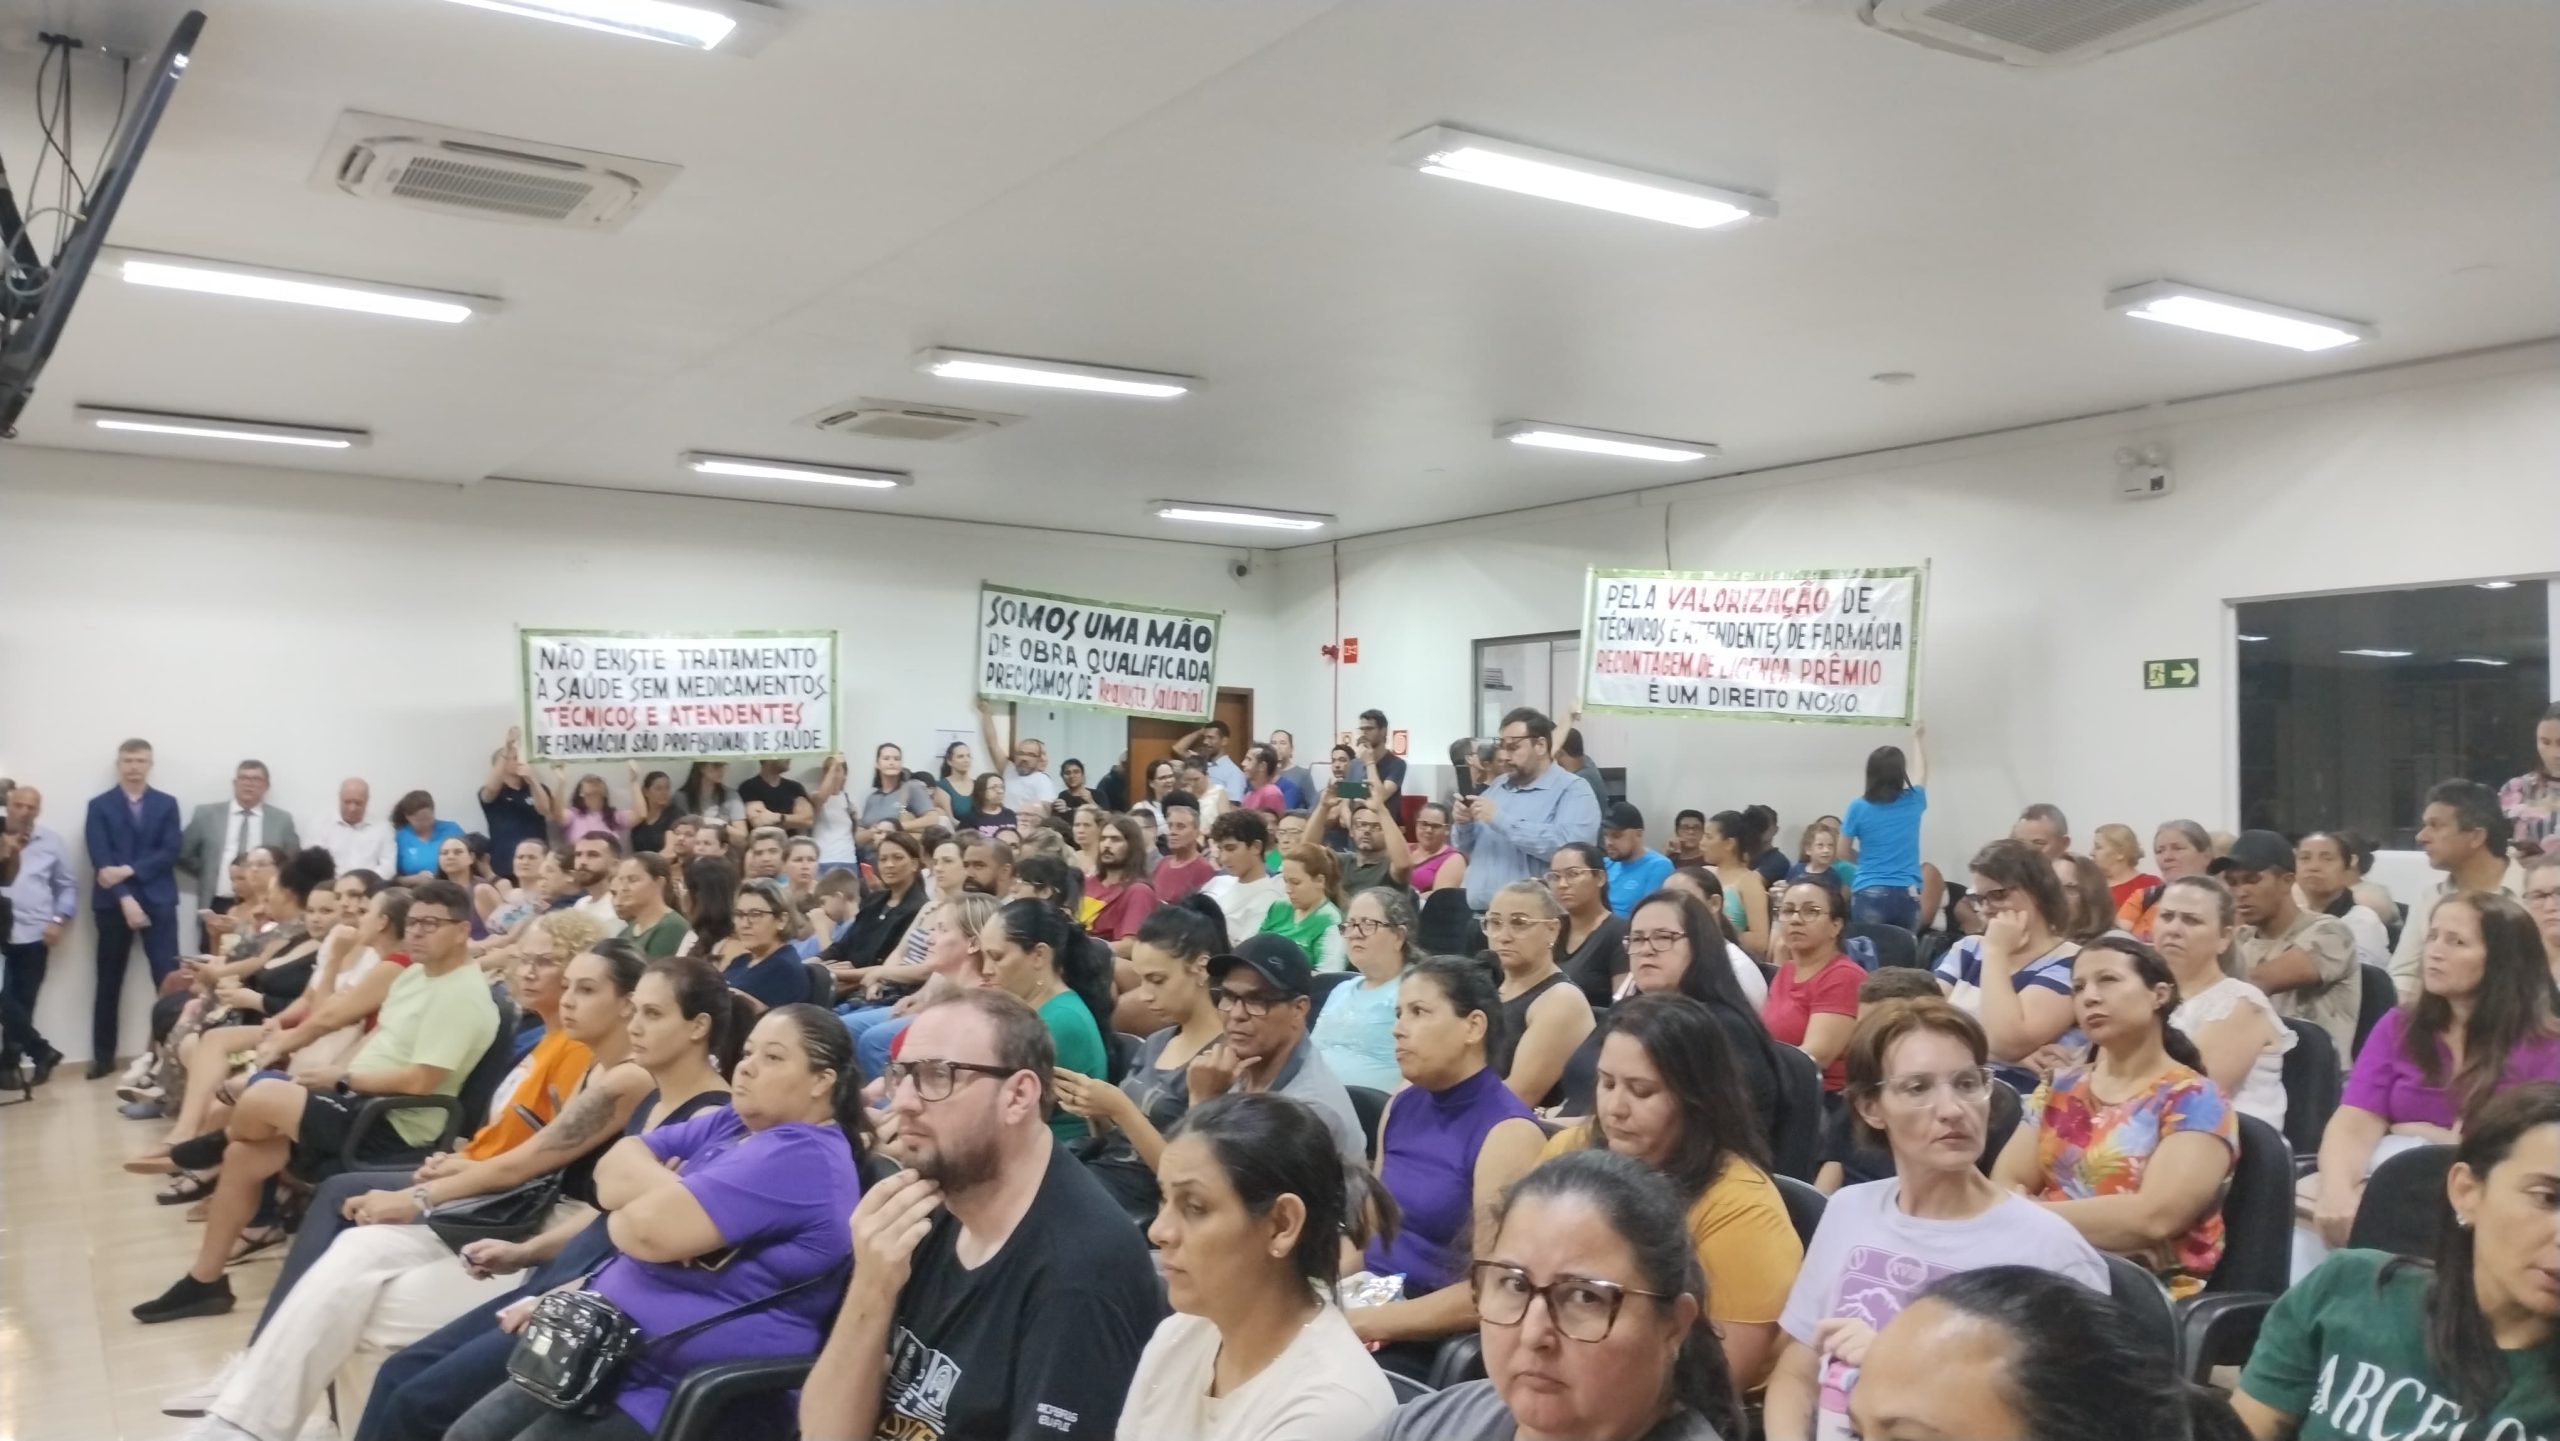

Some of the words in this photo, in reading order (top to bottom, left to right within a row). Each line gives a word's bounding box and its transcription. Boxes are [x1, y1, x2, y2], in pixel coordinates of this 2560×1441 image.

[1605, 584, 1656, 610] PELA
[1668, 580, 1830, 619] VALORIZAÇÃO
[1842, 586, 1873, 614] DE
[985, 595, 1080, 641] SOMOS
[1085, 611, 1138, 646] UMA
[1145, 617, 1212, 653] MÃO
[1598, 609, 1665, 647] TÉCNICOS
[1787, 622, 1807, 650] DE
[1812, 616, 1903, 651] FARMÁCIA
[540, 642, 584, 670] NÃO
[595, 647, 666, 676] EXISTE
[677, 647, 817, 670] TRATAMENTO
[988, 633, 1011, 658] DE
[1020, 638, 1079, 668] OBRA
[1087, 647, 1211, 684] QUALIFICADA
[1596, 649, 1694, 676] RECONTAGEM
[1697, 652, 1714, 678] DE
[1801, 652, 1882, 686] PRÊMIO
[554, 671, 623, 702] SAÚDE
[630, 676, 669, 702] SEM
[677, 674, 827, 700] MEDICAMENTOS
[986, 662, 1073, 700] PRECISAMOS
[1077, 674, 1092, 700] DE
[1667, 684, 1698, 706] UM
[1709, 686, 1789, 709] DIREITO
[543, 700, 637, 731] TÉCNICOS
[647, 705, 658, 726] E
[670, 702, 804, 727] ATENDENTES
[537, 735, 551, 754] DE
[557, 727, 626, 753] FARMÁCIA
[632, 729, 658, 753] SÃO
[754, 731, 769, 751] DE
[774, 725, 822, 752] SAÚDE
